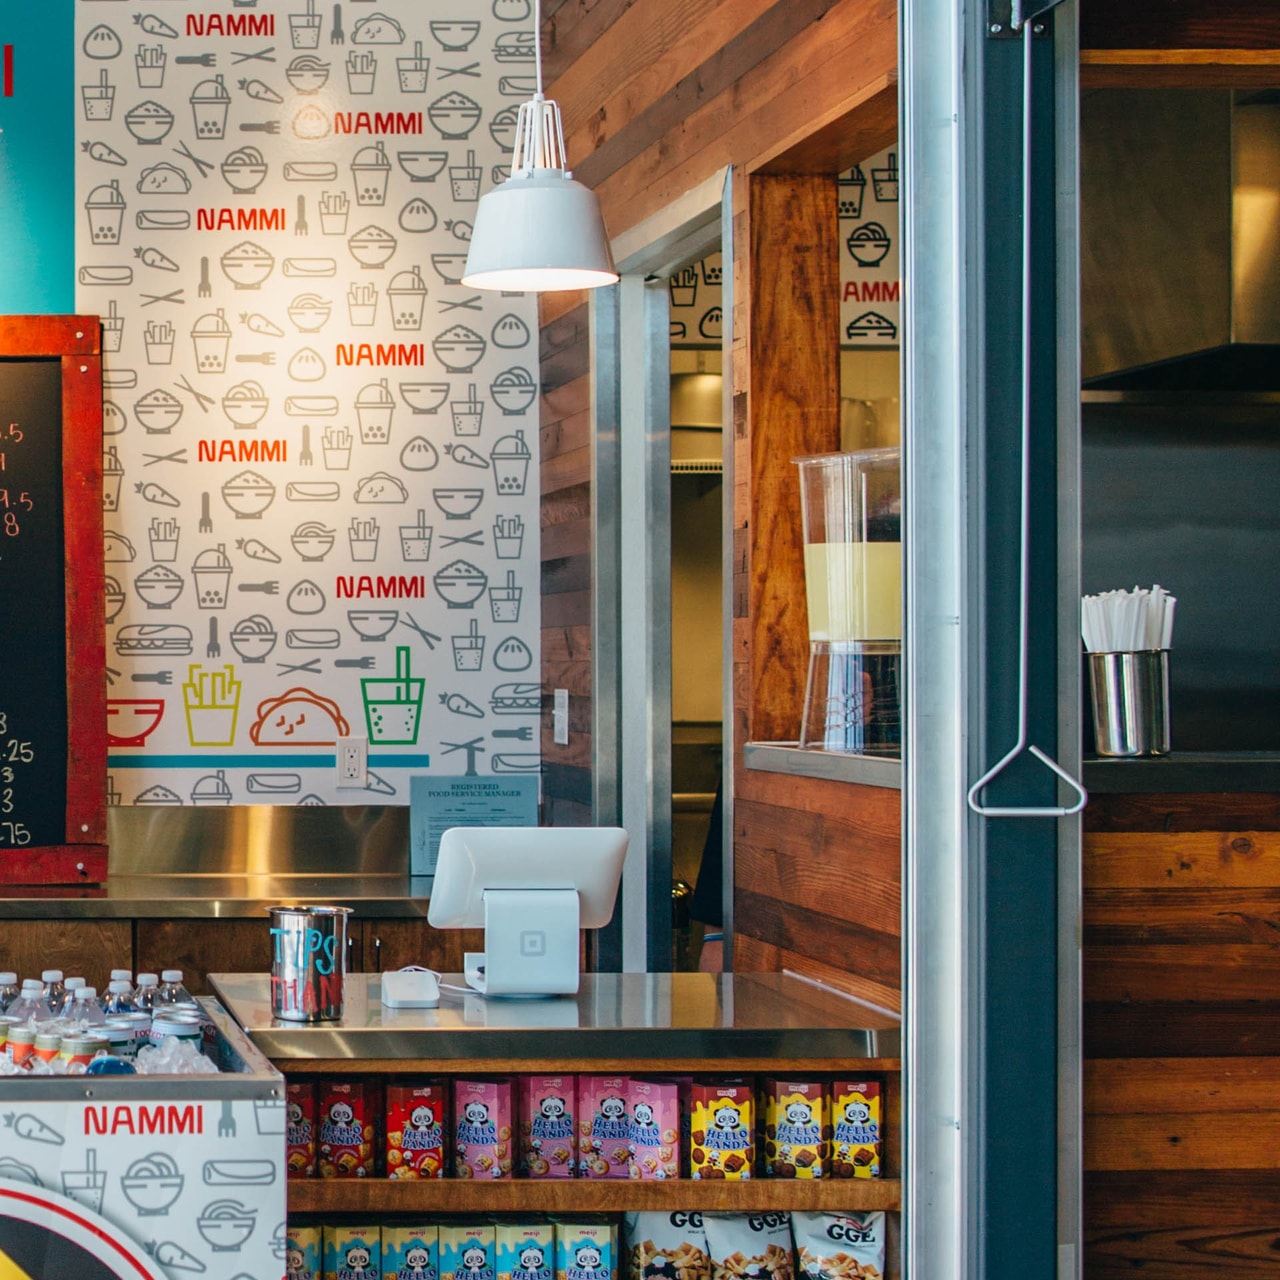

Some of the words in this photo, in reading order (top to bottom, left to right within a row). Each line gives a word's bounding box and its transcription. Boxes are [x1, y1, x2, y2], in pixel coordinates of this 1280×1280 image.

[186, 13, 276, 37] NAMMI
[333, 111, 424, 135] NAMMI
[196, 208, 287, 232] NAMMI
[336, 342, 425, 367] NAMMI
[197, 439, 287, 463] NAMMI
[335, 575, 426, 599] NAMMI
[269, 927, 339, 975] TIPS
[84, 1105, 203, 1135] NAMMI
